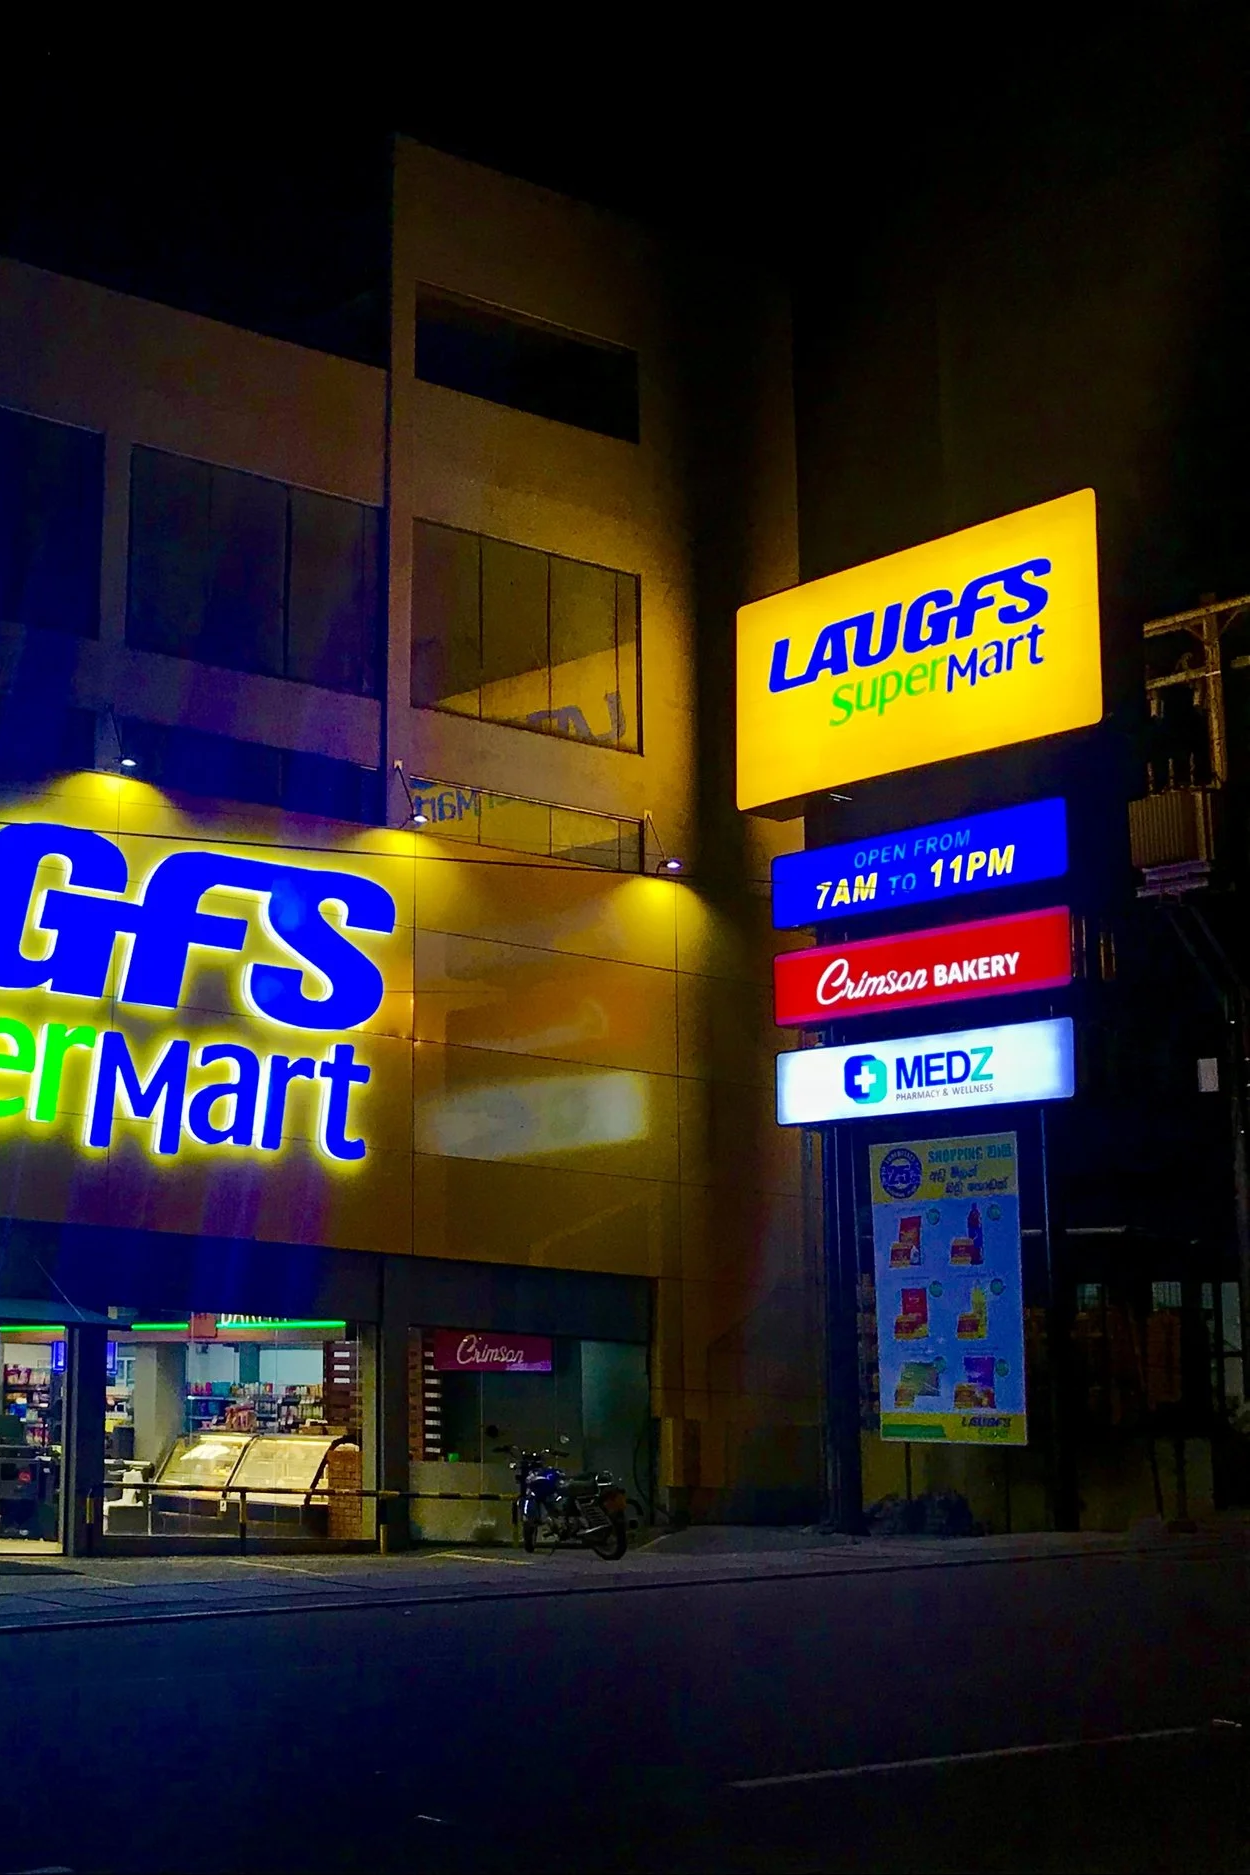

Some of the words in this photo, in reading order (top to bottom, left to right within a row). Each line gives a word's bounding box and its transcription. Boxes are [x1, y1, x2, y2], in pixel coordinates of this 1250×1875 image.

[768, 557, 1052, 694] LAUGFS
[853, 843, 907, 869] OPEN
[913, 829, 971, 857] FROM
[816, 871, 878, 910] 7AM
[888, 871, 917, 896] TO
[930, 844, 1015, 888] 11PM
[816, 958, 928, 1006] Crimson
[933, 951, 1020, 987] BAKERY
[895, 1046, 994, 1090] MEDZ
[895, 1088, 940, 1101] PHARMACY
[942, 1087, 949, 1097] &
[952, 1082, 994, 1096] WELLNESS
[456, 1333, 524, 1365] Crimson
